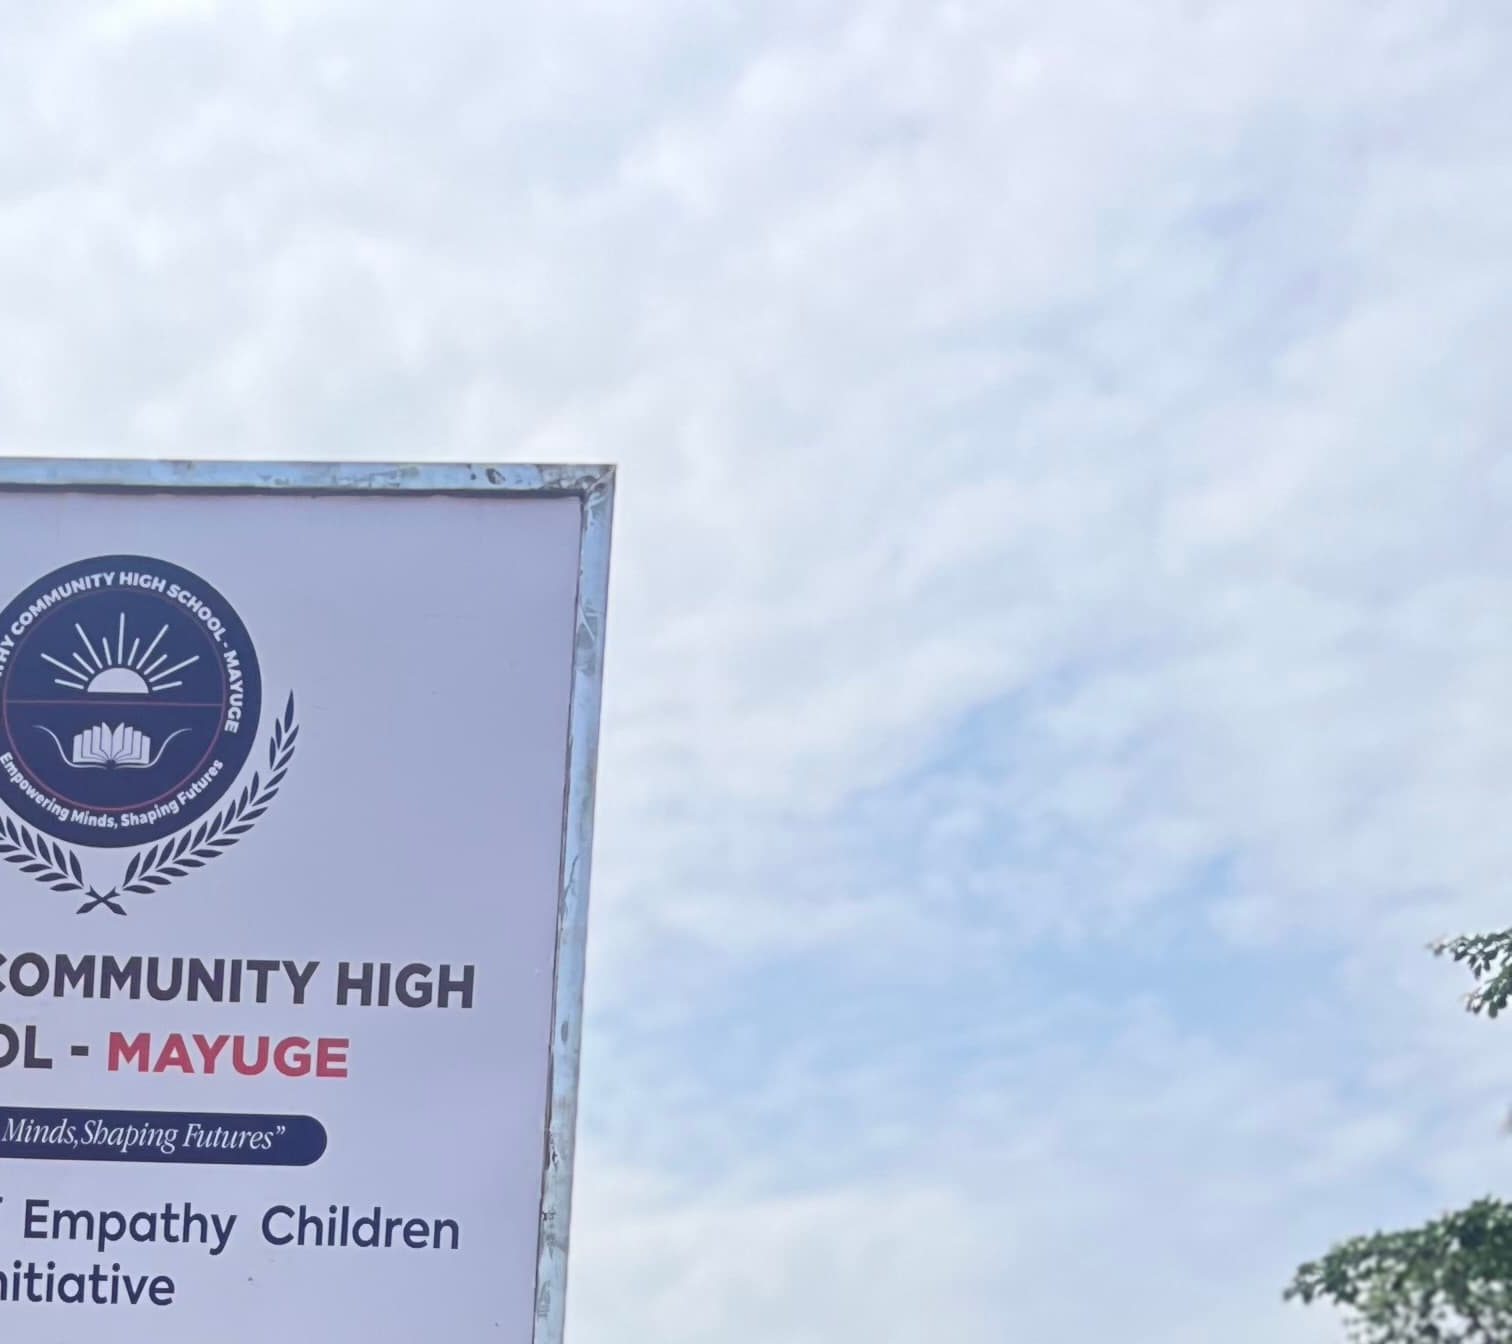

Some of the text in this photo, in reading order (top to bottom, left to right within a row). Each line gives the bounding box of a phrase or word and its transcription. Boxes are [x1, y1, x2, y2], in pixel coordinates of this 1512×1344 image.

[10, 571, 115, 636] COMMUNITY
[119, 571, 167, 593] HIGH
[166, 583, 227, 642] SCHOOL
[223, 649, 244, 734] MAYUGE
[0, 751, 224, 829] Empowering Minds, Shaping Futures
[337, 962, 474, 1008] HIGH
[71, 1046, 88, 1056] -
[108, 1032, 349, 1077] MAYUGE
[24, 1199, 237, 1255] Empathy
[262, 1205, 458, 1249] Children
